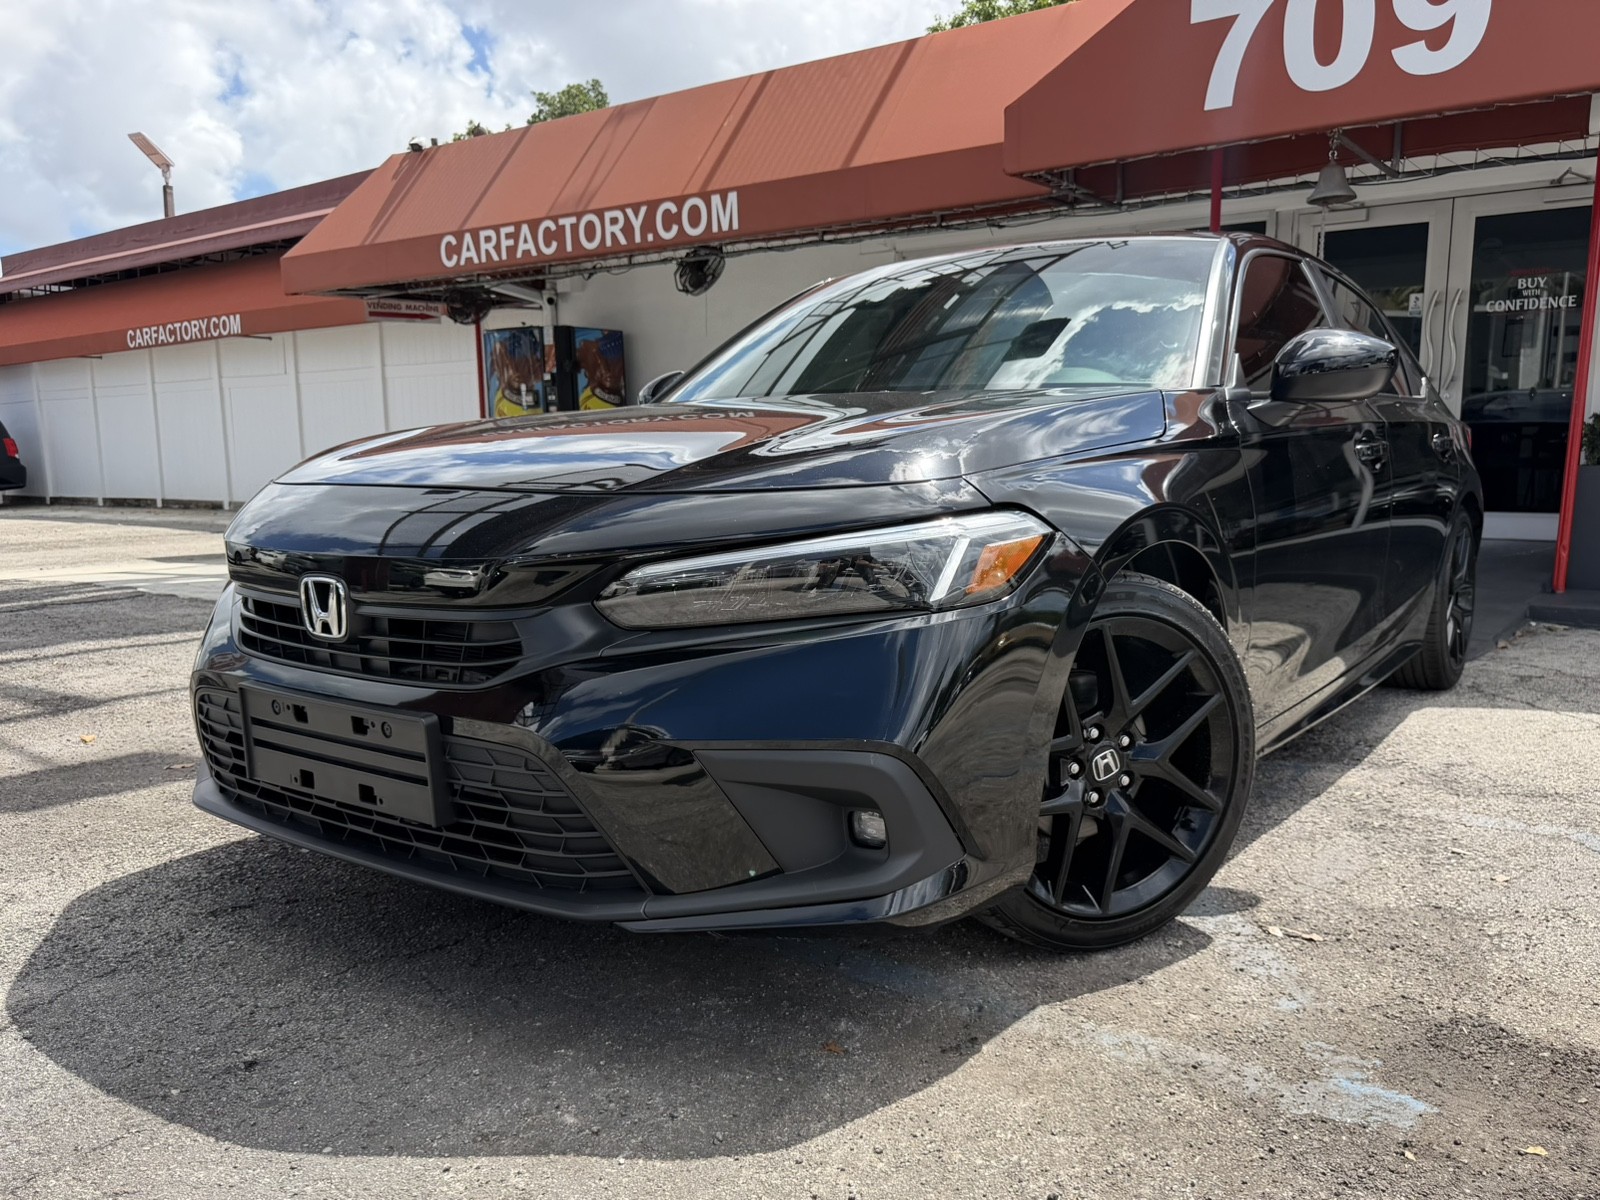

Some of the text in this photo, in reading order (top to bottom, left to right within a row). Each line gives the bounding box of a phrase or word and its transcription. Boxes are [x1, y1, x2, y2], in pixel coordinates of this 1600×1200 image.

[1190, 0, 1492, 111] 709
[440, 191, 739, 268] CARFACTORY.COM
[1517, 277, 1547, 289] BUY
[1522, 288, 1541, 297] WITH
[366, 302, 402, 310] VENDING
[1486, 295, 1577, 312] CONFIDENCE
[126, 313, 241, 348] CARFACTORY.COM
